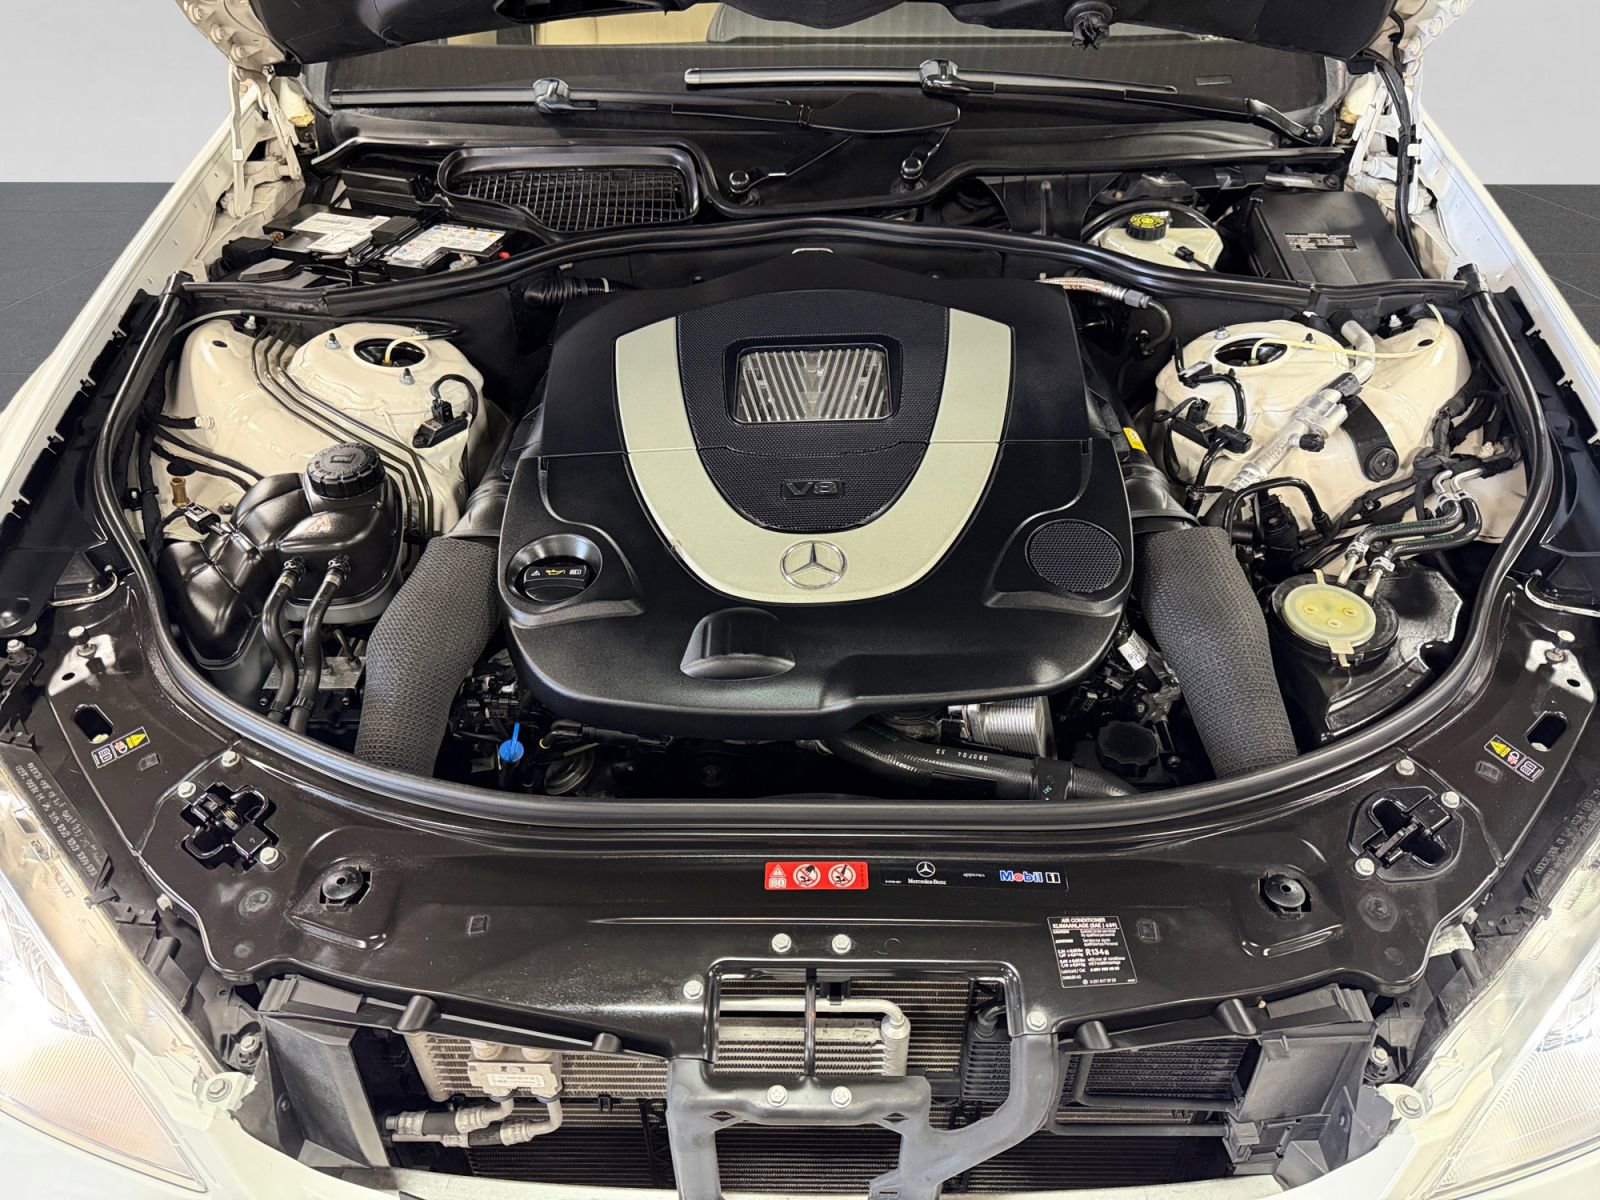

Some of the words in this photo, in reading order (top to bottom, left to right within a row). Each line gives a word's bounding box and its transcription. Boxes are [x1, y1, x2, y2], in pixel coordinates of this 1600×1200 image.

[785, 481, 838, 496] V8
[999, 869, 1044, 883] Mobil
[1085, 948, 1110, 956] R134a
